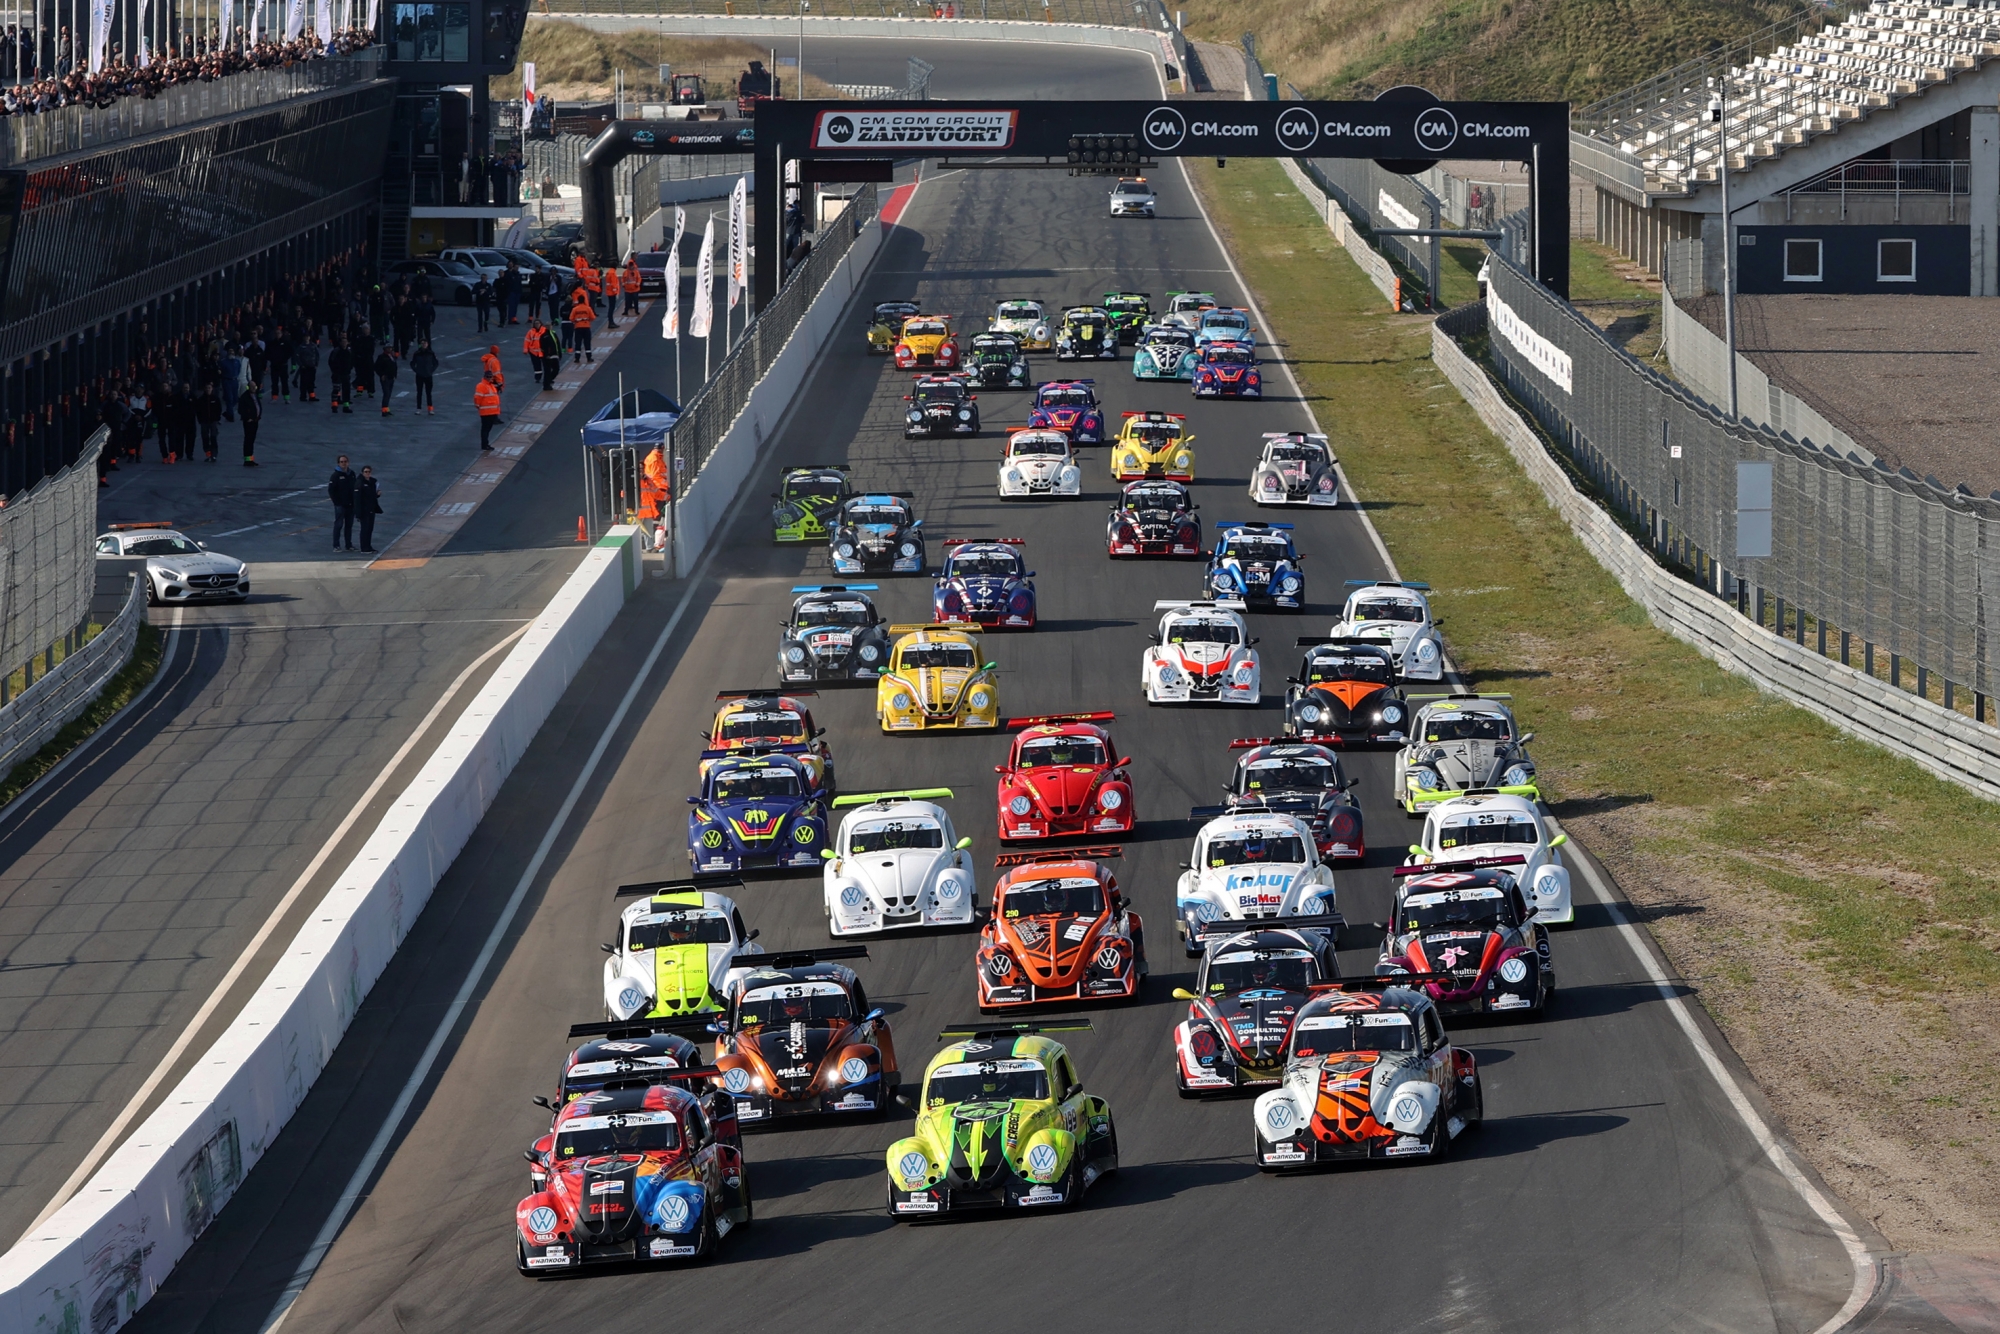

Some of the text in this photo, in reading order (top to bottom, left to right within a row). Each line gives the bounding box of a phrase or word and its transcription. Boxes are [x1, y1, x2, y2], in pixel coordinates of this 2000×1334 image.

[861, 116, 1004, 125] CM.COM CIRCUIT
[858, 126, 1002, 142] ZANDVOORT
[1191, 122, 1258, 138] CM.com
[1324, 122, 1391, 138] CM.com
[1463, 122, 1530, 138] CM.com
[1246, 829, 1263, 839] 25
[1211, 859, 1225, 867] 999
[1226, 874, 1295, 893] KNAUF
[1239, 894, 1281, 906] BigMat
[1443, 890, 1461, 902] 25
[1005, 909, 1019, 918] 290
[1408, 920, 1419, 929] 13
[1210, 983, 1225, 991] 465
[784, 986, 803, 998] 25
[742, 1015, 758, 1024] 280
[1375, 1016, 1402, 1024] FunCup
[1234, 1022, 1255, 1030] TMD
[1237, 1027, 1287, 1035] CONSULTING
[1297, 1049, 1314, 1057] 477
[929, 1097, 945, 1107] 199
[638, 1114, 666, 1123] FunCup
[563, 1146, 575, 1155] 02
[536, 1233, 554, 1241] BELL
